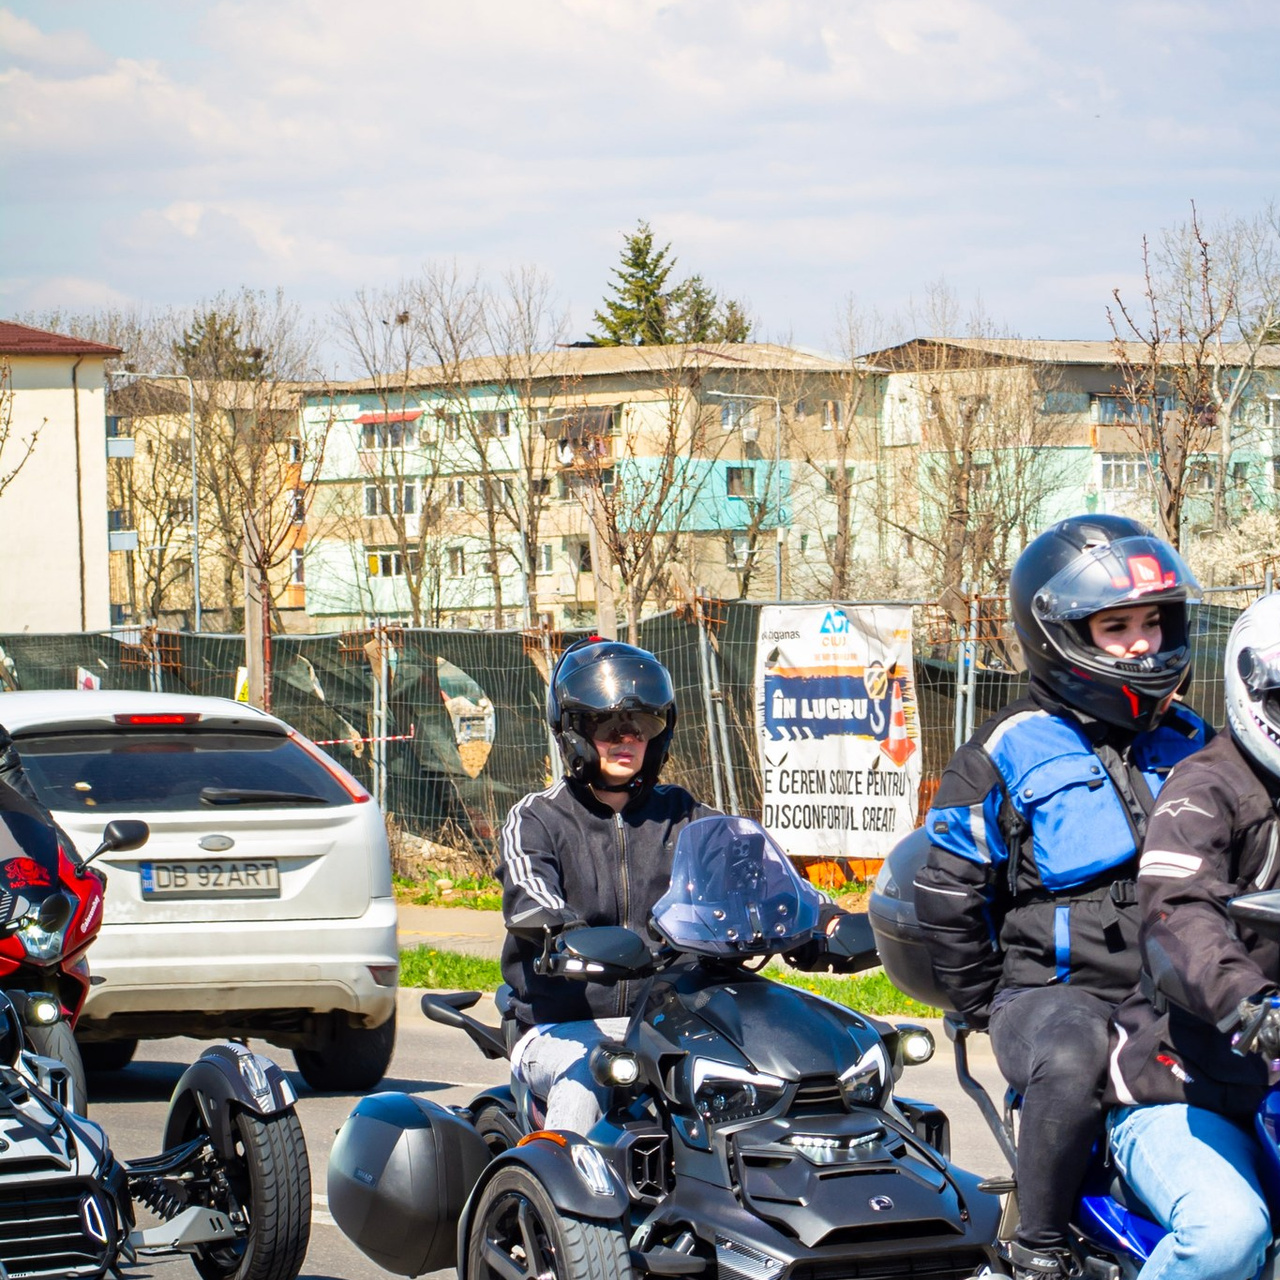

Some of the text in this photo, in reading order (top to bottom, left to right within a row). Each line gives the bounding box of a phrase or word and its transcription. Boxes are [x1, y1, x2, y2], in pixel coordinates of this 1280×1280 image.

[772, 688, 868, 720] ÎN LUCRU
[779, 769, 827, 795] CEREM
[829, 769, 863, 795] SCUZE
[866, 770, 906, 797] PENTRU
[764, 804, 897, 832] DISCONFORTUL CREAT!
[156, 865, 188, 888] DB
